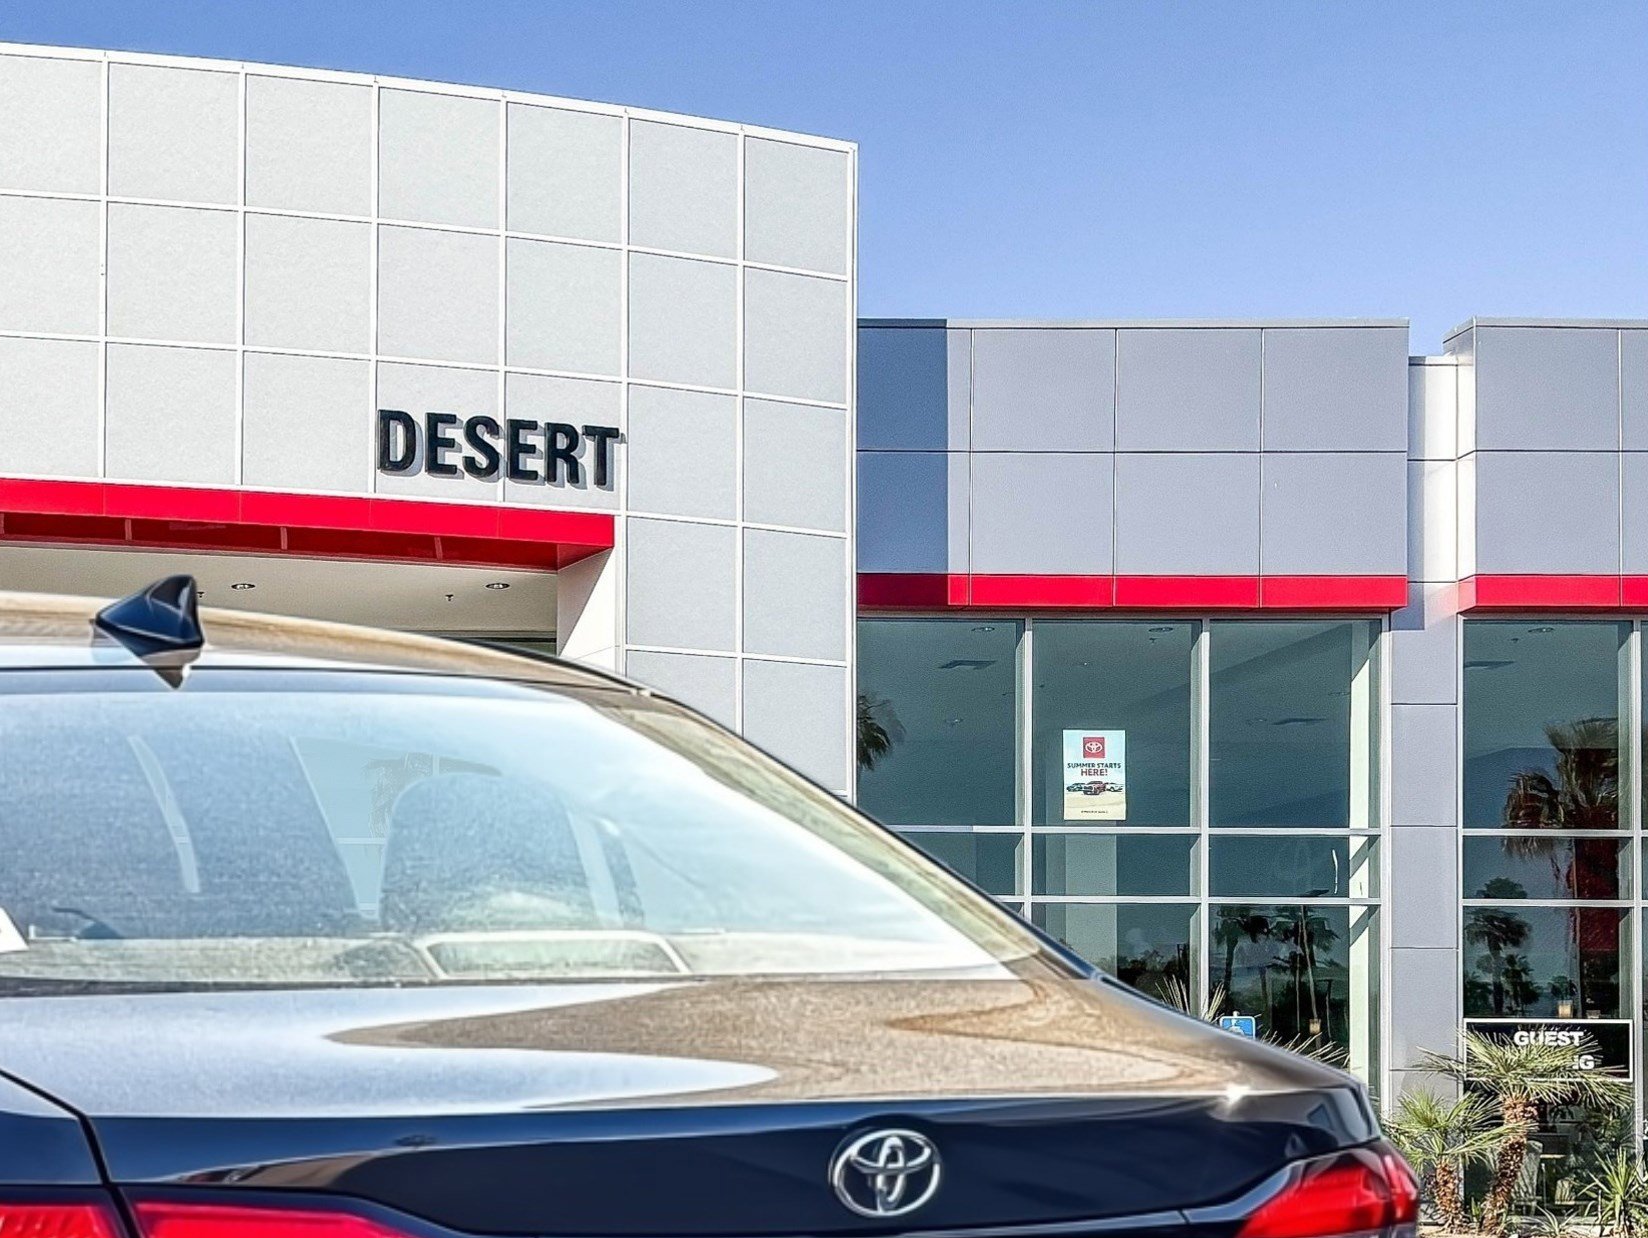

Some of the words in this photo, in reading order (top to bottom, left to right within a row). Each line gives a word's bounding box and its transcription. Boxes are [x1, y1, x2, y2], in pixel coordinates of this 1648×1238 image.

[376, 409, 620, 487] DESERT
[1080, 768, 1108, 776] HERE!
[1513, 1030, 1585, 1047] GUEST
